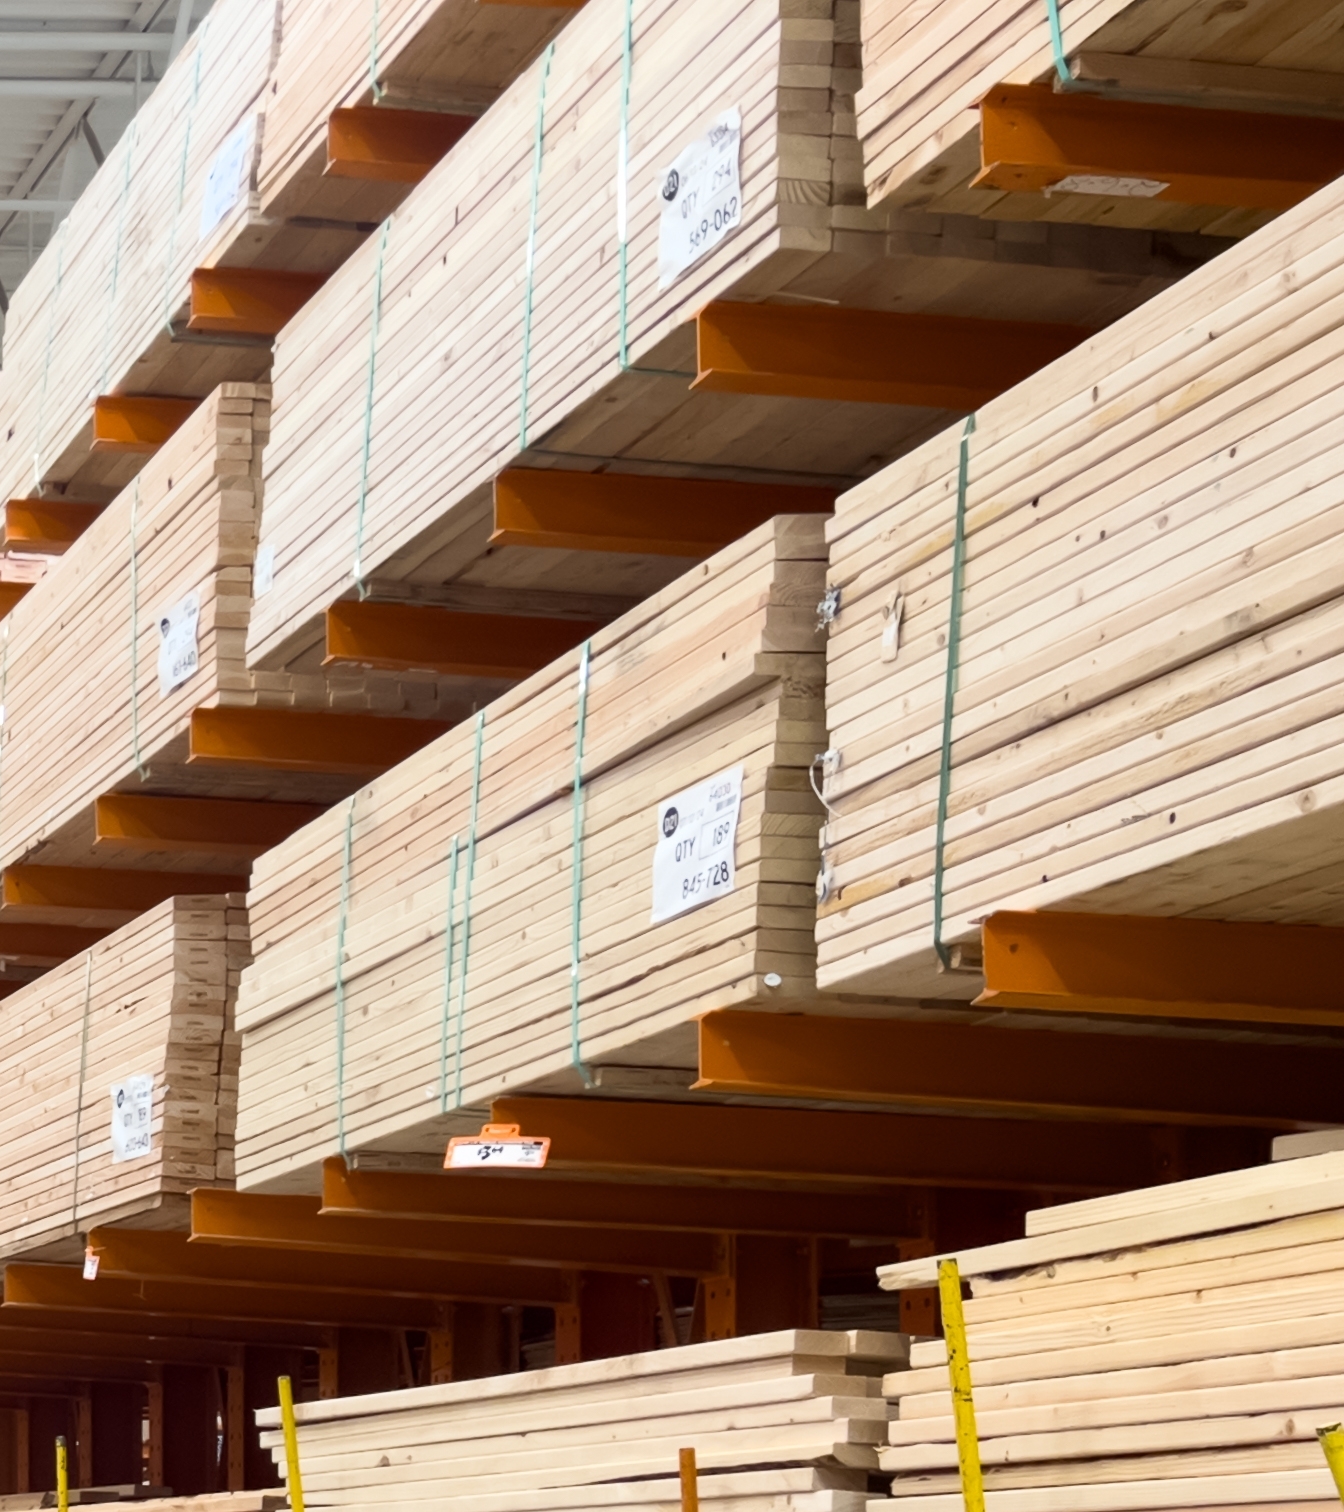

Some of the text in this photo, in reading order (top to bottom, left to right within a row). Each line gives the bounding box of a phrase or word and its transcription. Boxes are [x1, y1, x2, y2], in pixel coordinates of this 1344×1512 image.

[681, 186, 700, 219] QTY
[689, 196, 738, 255] 569-062
[675, 836, 697, 863] QTY
[682, 860, 730, 901] 845-728
